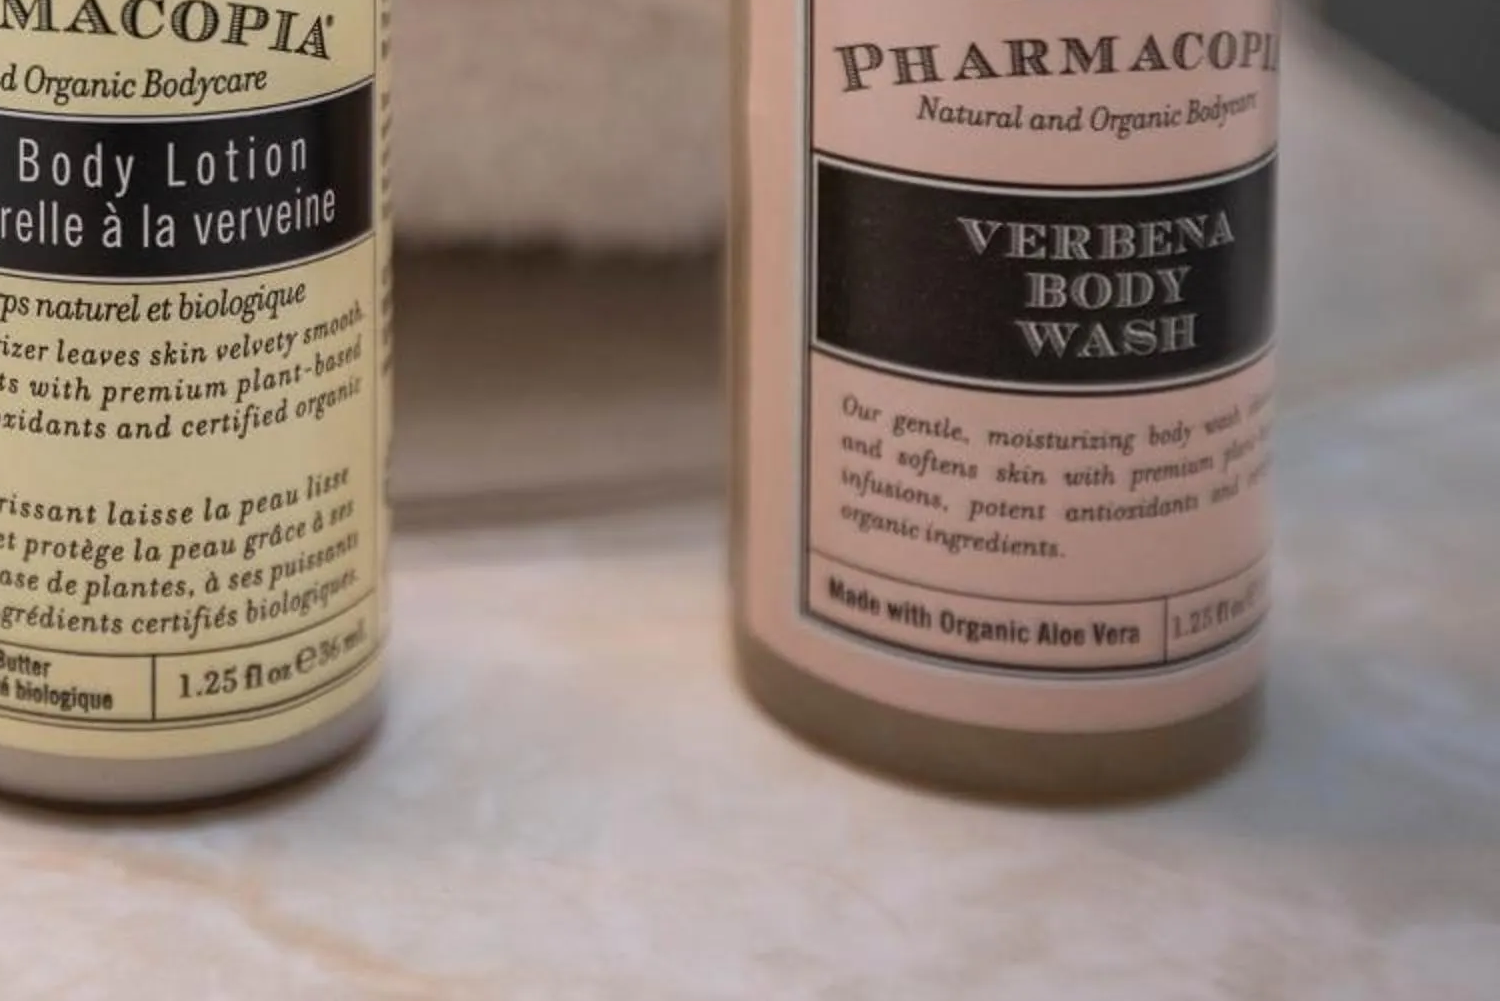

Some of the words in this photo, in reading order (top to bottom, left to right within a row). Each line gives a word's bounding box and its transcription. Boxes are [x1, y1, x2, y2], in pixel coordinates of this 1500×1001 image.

[24, 64, 137, 105] Organic
[143, 68, 268, 107] Bodycare
[916, 95, 1023, 130] Natural
[1029, 107, 1083, 133] and
[1089, 104, 1183, 141] Organic
[19, 138, 135, 198] Body
[167, 135, 307, 187] Lotion
[101, 204, 124, 249] à
[142, 204, 176, 249] la
[193, 186, 337, 247] verveine
[956, 208, 1237, 261] VERBENA
[35, 292, 141, 323] naturel
[146, 297, 173, 323] et
[178, 282, 307, 324] biologique
[1024, 265, 1193, 309] BODY
[56, 338, 141, 367] leaves
[149, 340, 208, 367] skin
[216, 330, 299, 362] velvety
[1014, 312, 1200, 359] WASH
[29, 376, 92, 402] with
[99, 378, 229, 412] premium
[235, 332, 362, 404] plant-based
[116, 413, 171, 440] and
[181, 397, 289, 440] certified
[295, 375, 362, 421] organic
[841, 395, 882, 424] Our
[892, 412, 970, 445] gentle,
[988, 428, 1135, 456] moisturizing
[1148, 419, 1195, 451] body
[841, 432, 883, 461] and
[896, 444, 978, 481] softens
[995, 463, 1046, 487] skin
[1063, 463, 1116, 487] with
[1129, 454, 1214, 493] premium
[107, 500, 194, 528] laisse
[203, 496, 231, 524] la
[237, 487, 301, 526] peau
[305, 466, 350, 501] lisse
[840, 466, 950, 515] infusions,
[966, 500, 1046, 524] potent
[1064, 493, 1200, 524] antioxidants
[22, 532, 126, 571] protège
[132, 536, 162, 562] la
[167, 537, 238, 570] peau
[243, 521, 307, 561] grâce
[311, 509, 324, 534] à
[329, 498, 355, 527] ses
[839, 502, 920, 543] organic
[925, 523, 1067, 559] ingredients.
[47, 570, 78, 597] de
[81, 573, 195, 606] plantes,
[204, 570, 220, 595] à
[227, 566, 264, 592] ses
[268, 529, 360, 591] puissants
[131, 603, 239, 640] certifiés
[827, 575, 881, 616] Made
[887, 596, 933, 631] with
[939, 608, 1030, 646] Organic
[1036, 618, 1086, 647] Aloe
[1092, 621, 1141, 645] Vera
[14, 681, 114, 713] biologique
[178, 664, 239, 699] 1.25
[243, 663, 264, 691] fl
[267, 662, 293, 686] oz
